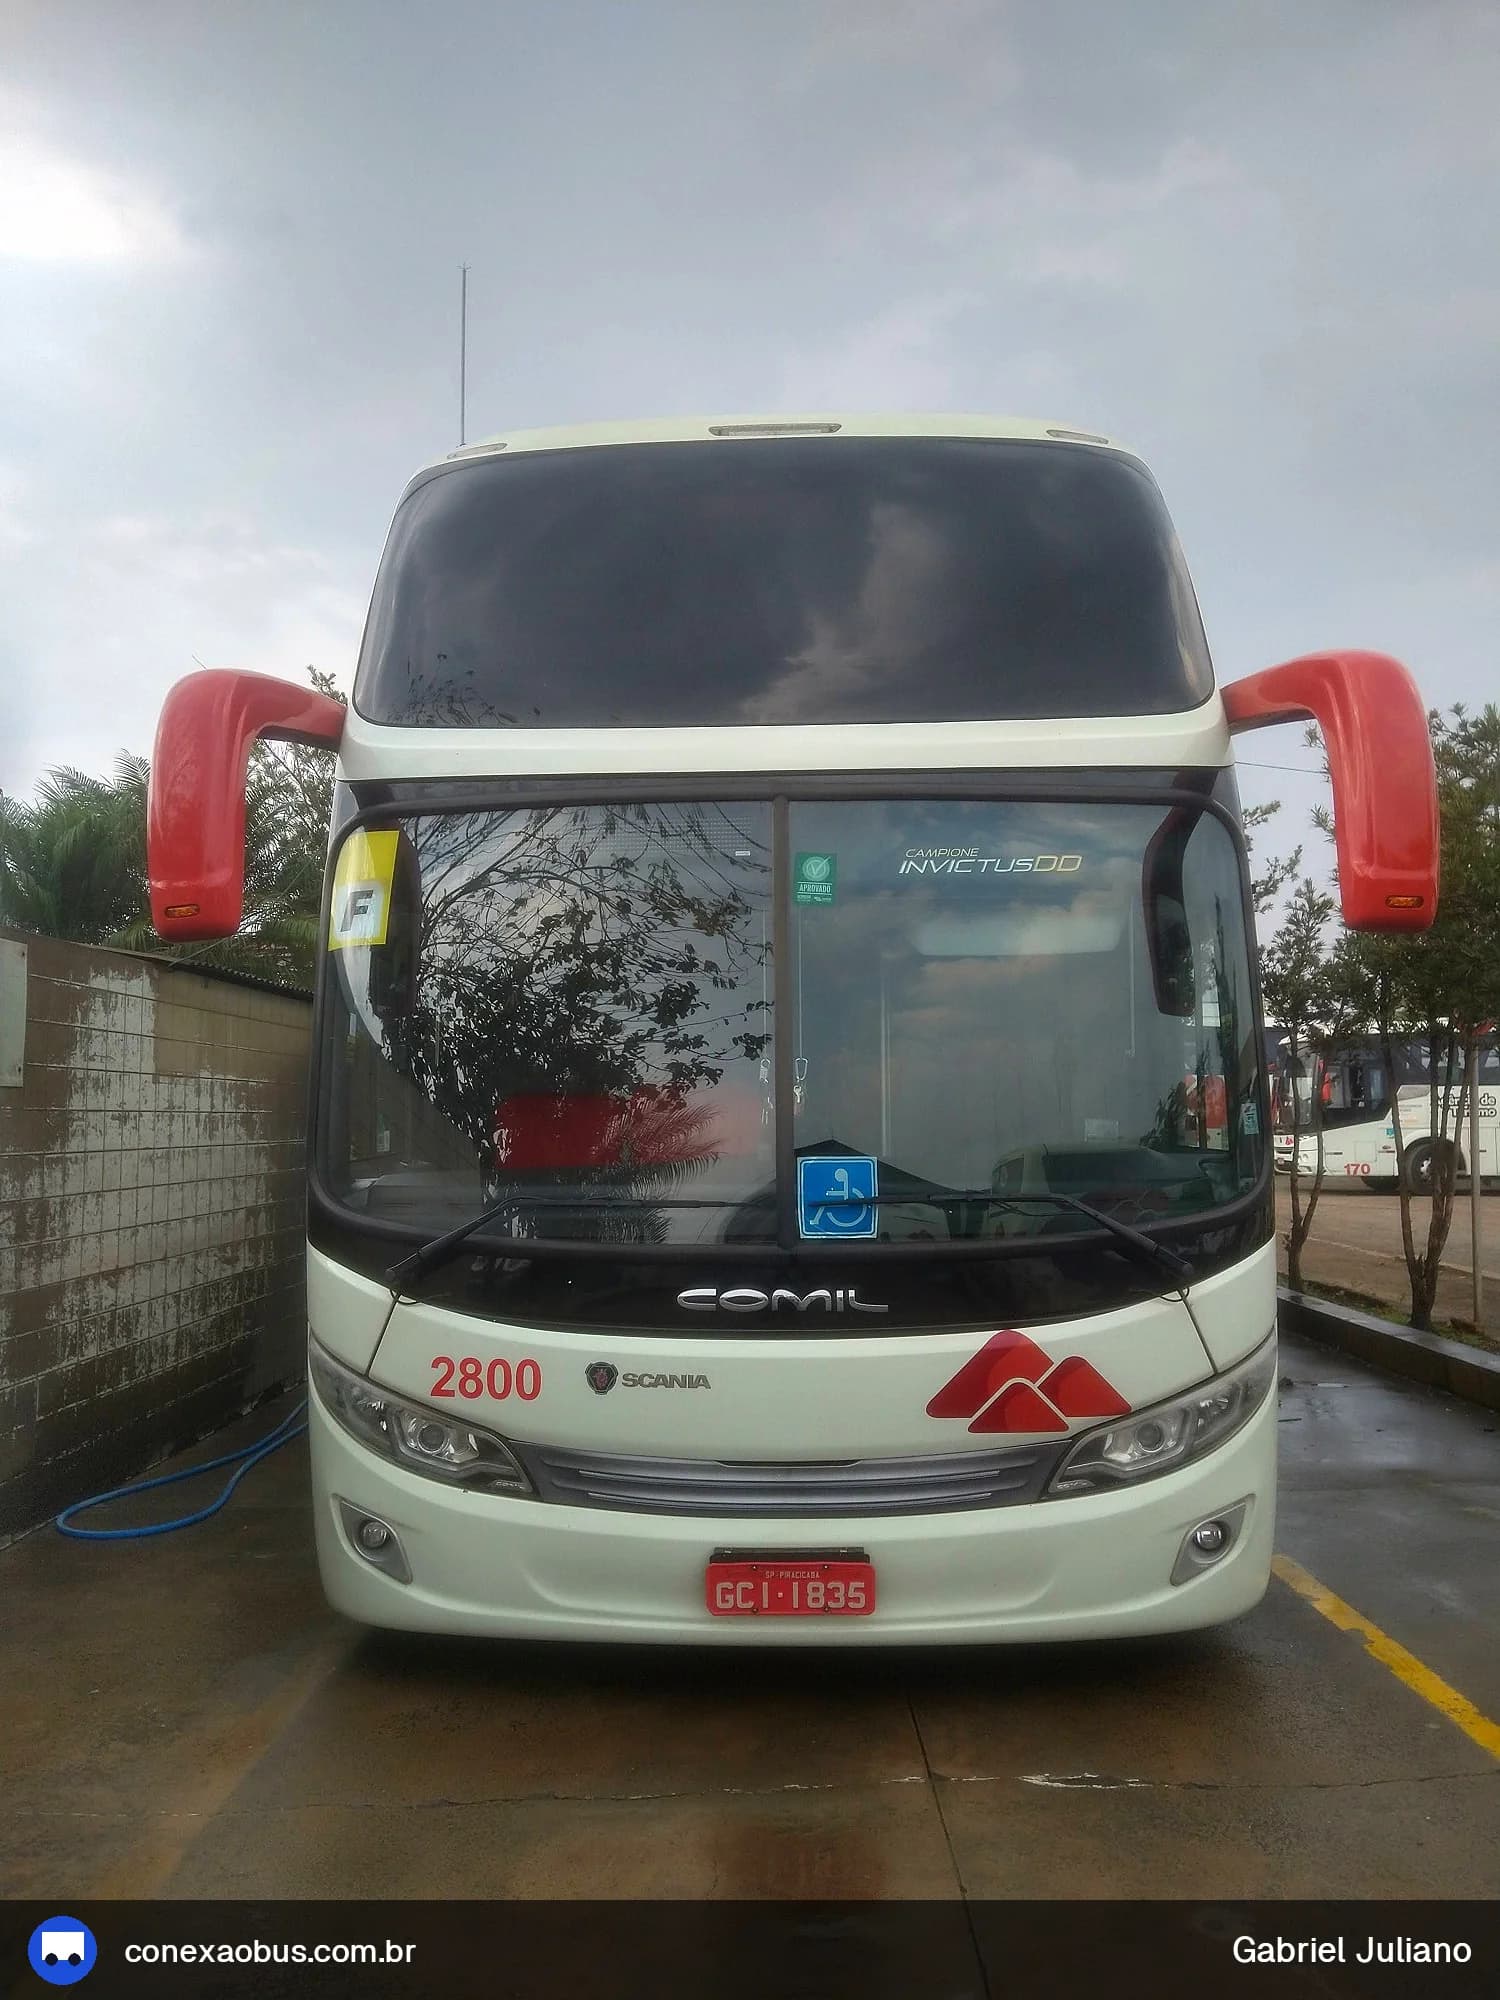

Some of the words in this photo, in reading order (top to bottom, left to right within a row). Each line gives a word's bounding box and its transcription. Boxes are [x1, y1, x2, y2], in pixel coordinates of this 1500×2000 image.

[905, 847, 979, 857] CAMPIONE
[799, 883, 831, 893] APROVADO
[340, 889, 374, 933] F
[1480, 1092, 1497, 1106] de
[1449, 1106, 1497, 1118] Trmo
[1343, 1163, 1371, 1176] 170
[677, 1288, 889, 1312] COMIL
[430, 1356, 542, 1401] 2800
[621, 1372, 712, 1390] SCANIA
